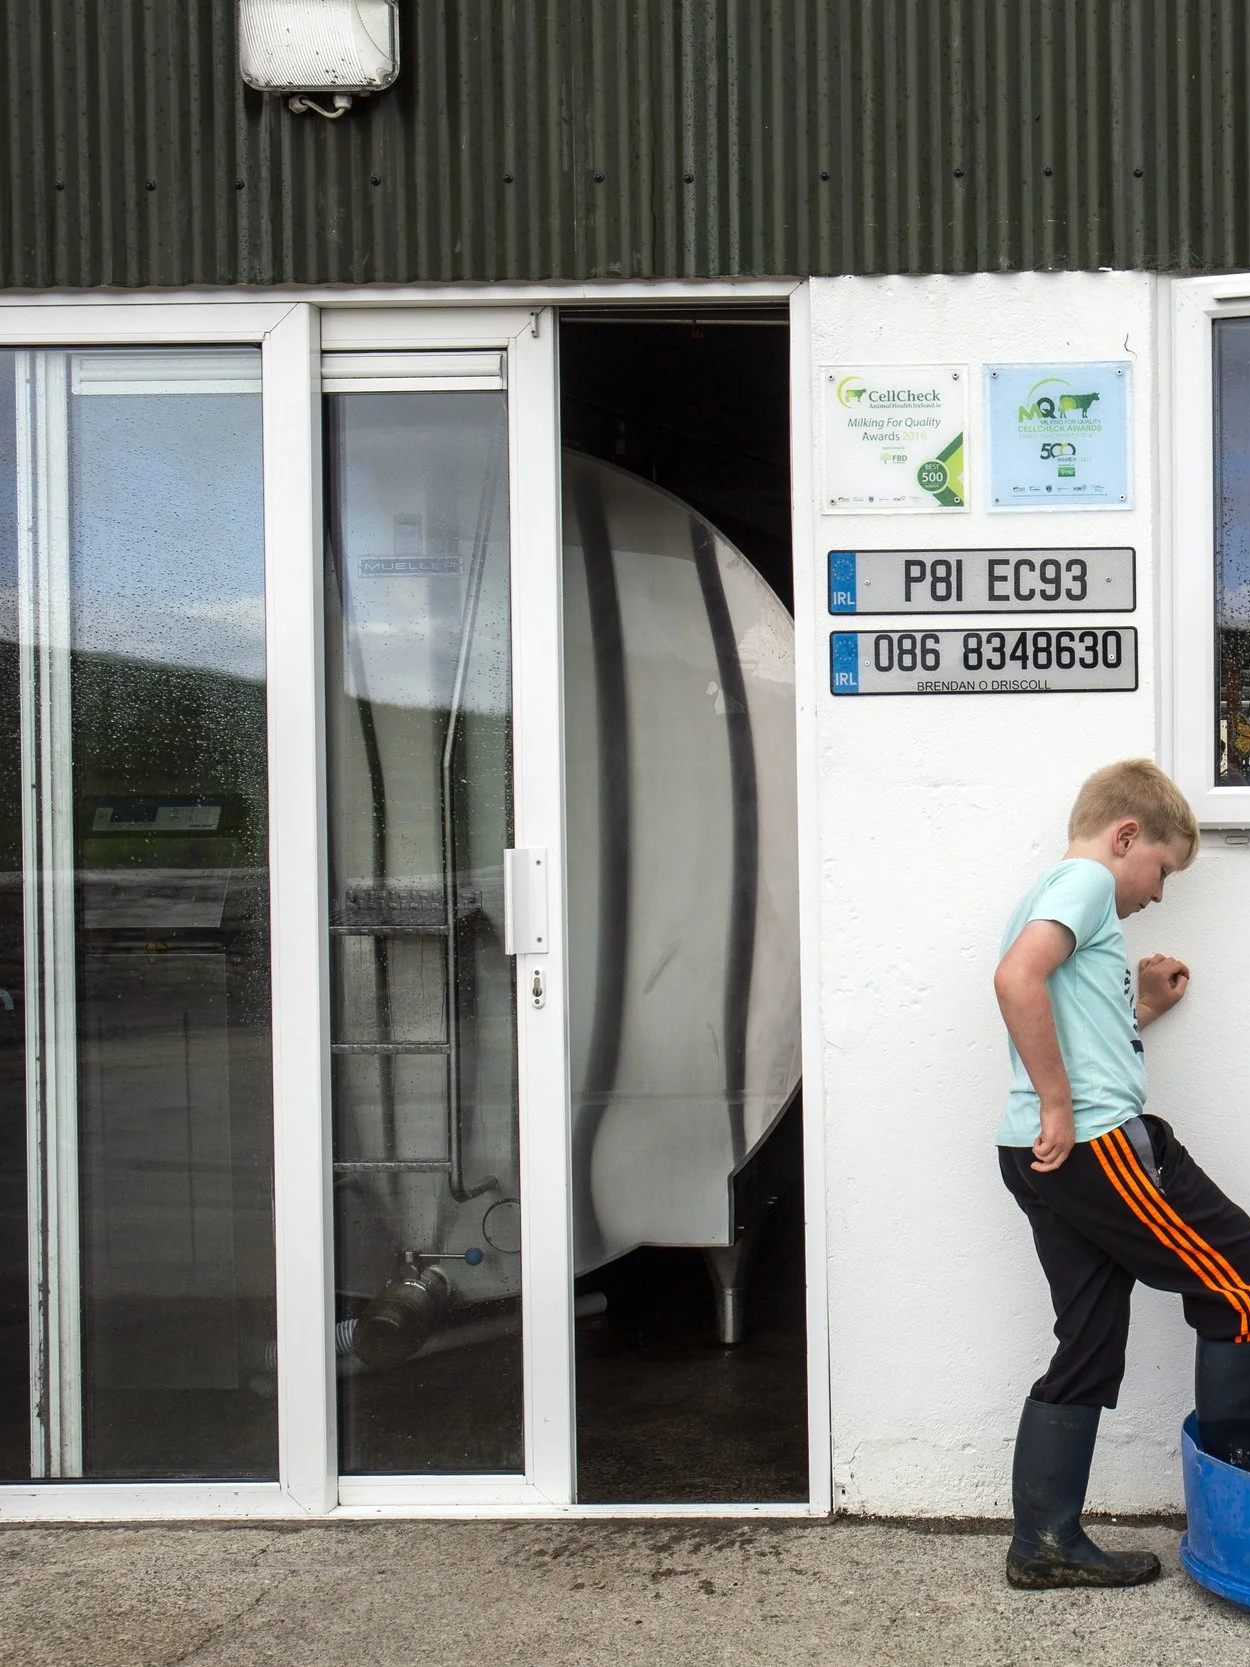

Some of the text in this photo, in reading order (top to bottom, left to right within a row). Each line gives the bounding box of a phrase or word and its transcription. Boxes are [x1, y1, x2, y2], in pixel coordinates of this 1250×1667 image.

[868, 389, 941, 402] CellCheck
[847, 416, 941, 429] Milking For Quality
[1018, 424, 1102, 433] CELLCHECK AWARDS
[862, 432, 900, 441] Awards
[921, 472, 944, 483] 500
[364, 562, 457, 571] MUELLER
[987, 558, 1088, 602] EC93
[833, 591, 856, 605] IRL
[874, 631, 1122, 672] 086 8348630
[835, 672, 857, 686] IRL
[917, 680, 1051, 691] BRENDAN O DRISCOLL
